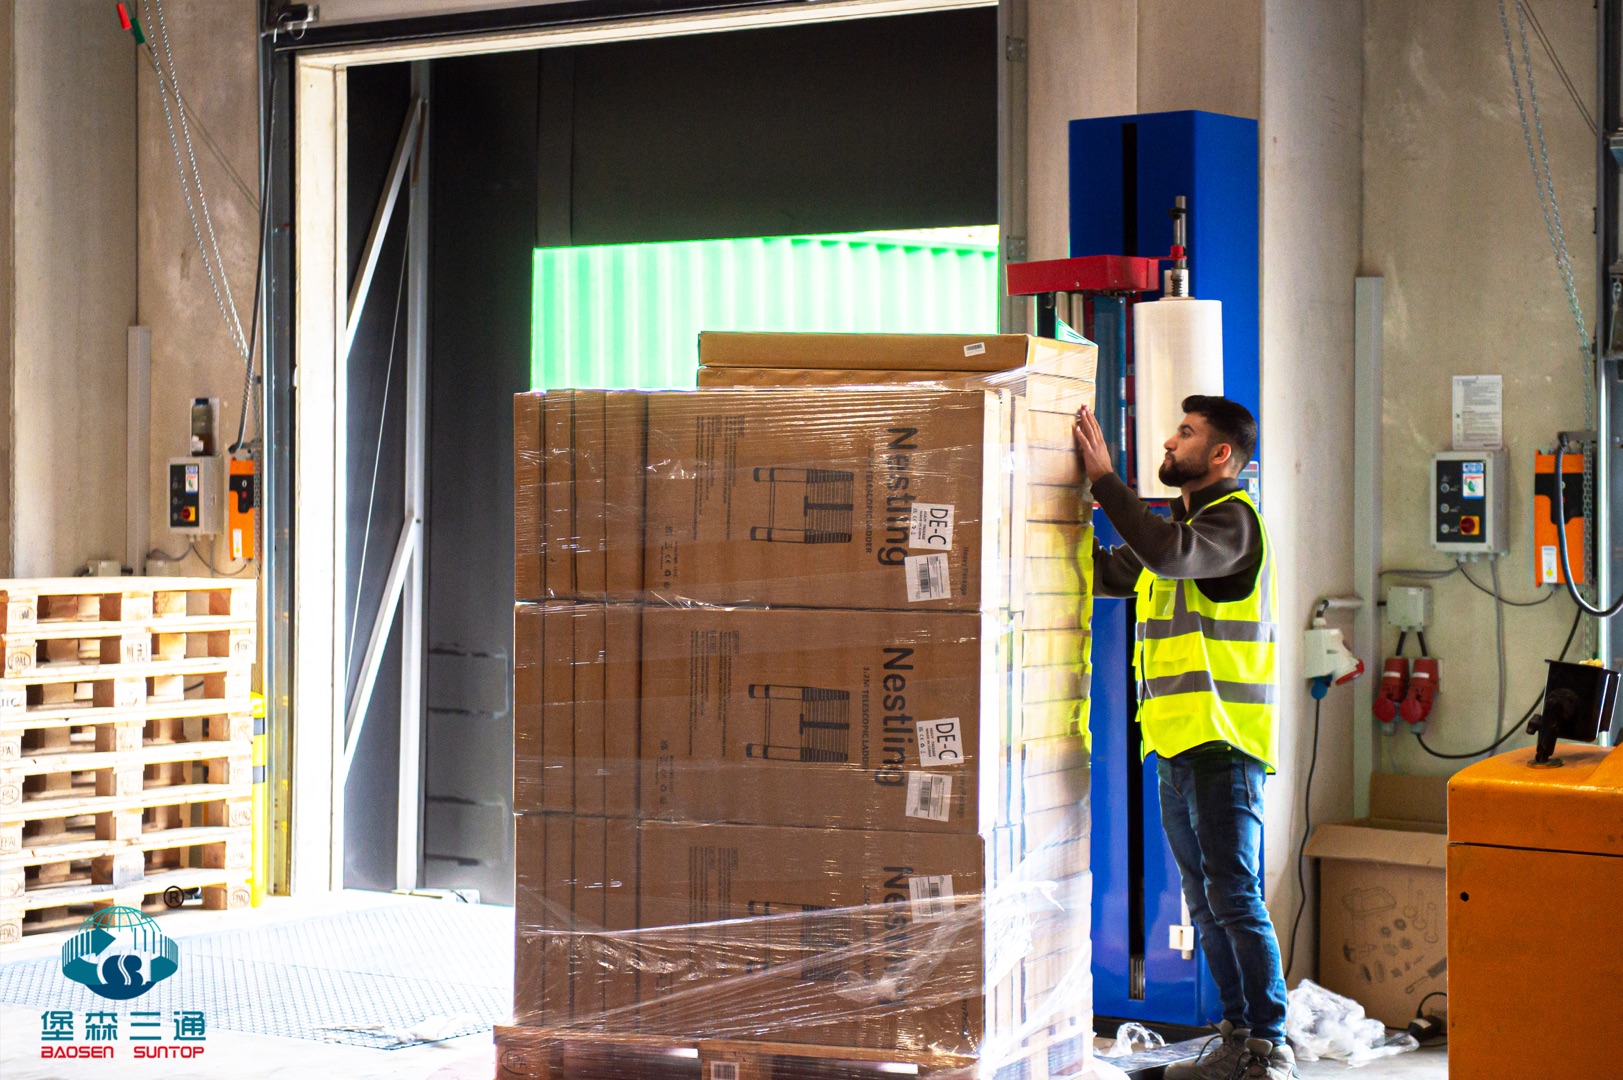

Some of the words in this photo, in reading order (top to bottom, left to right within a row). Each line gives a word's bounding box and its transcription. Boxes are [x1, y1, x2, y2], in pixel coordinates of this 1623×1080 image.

[877, 427, 918, 566] Nestling
[927, 508, 949, 545] DE-C
[874, 647, 914, 787] Nestling
[936, 722, 958, 760] DE-C
